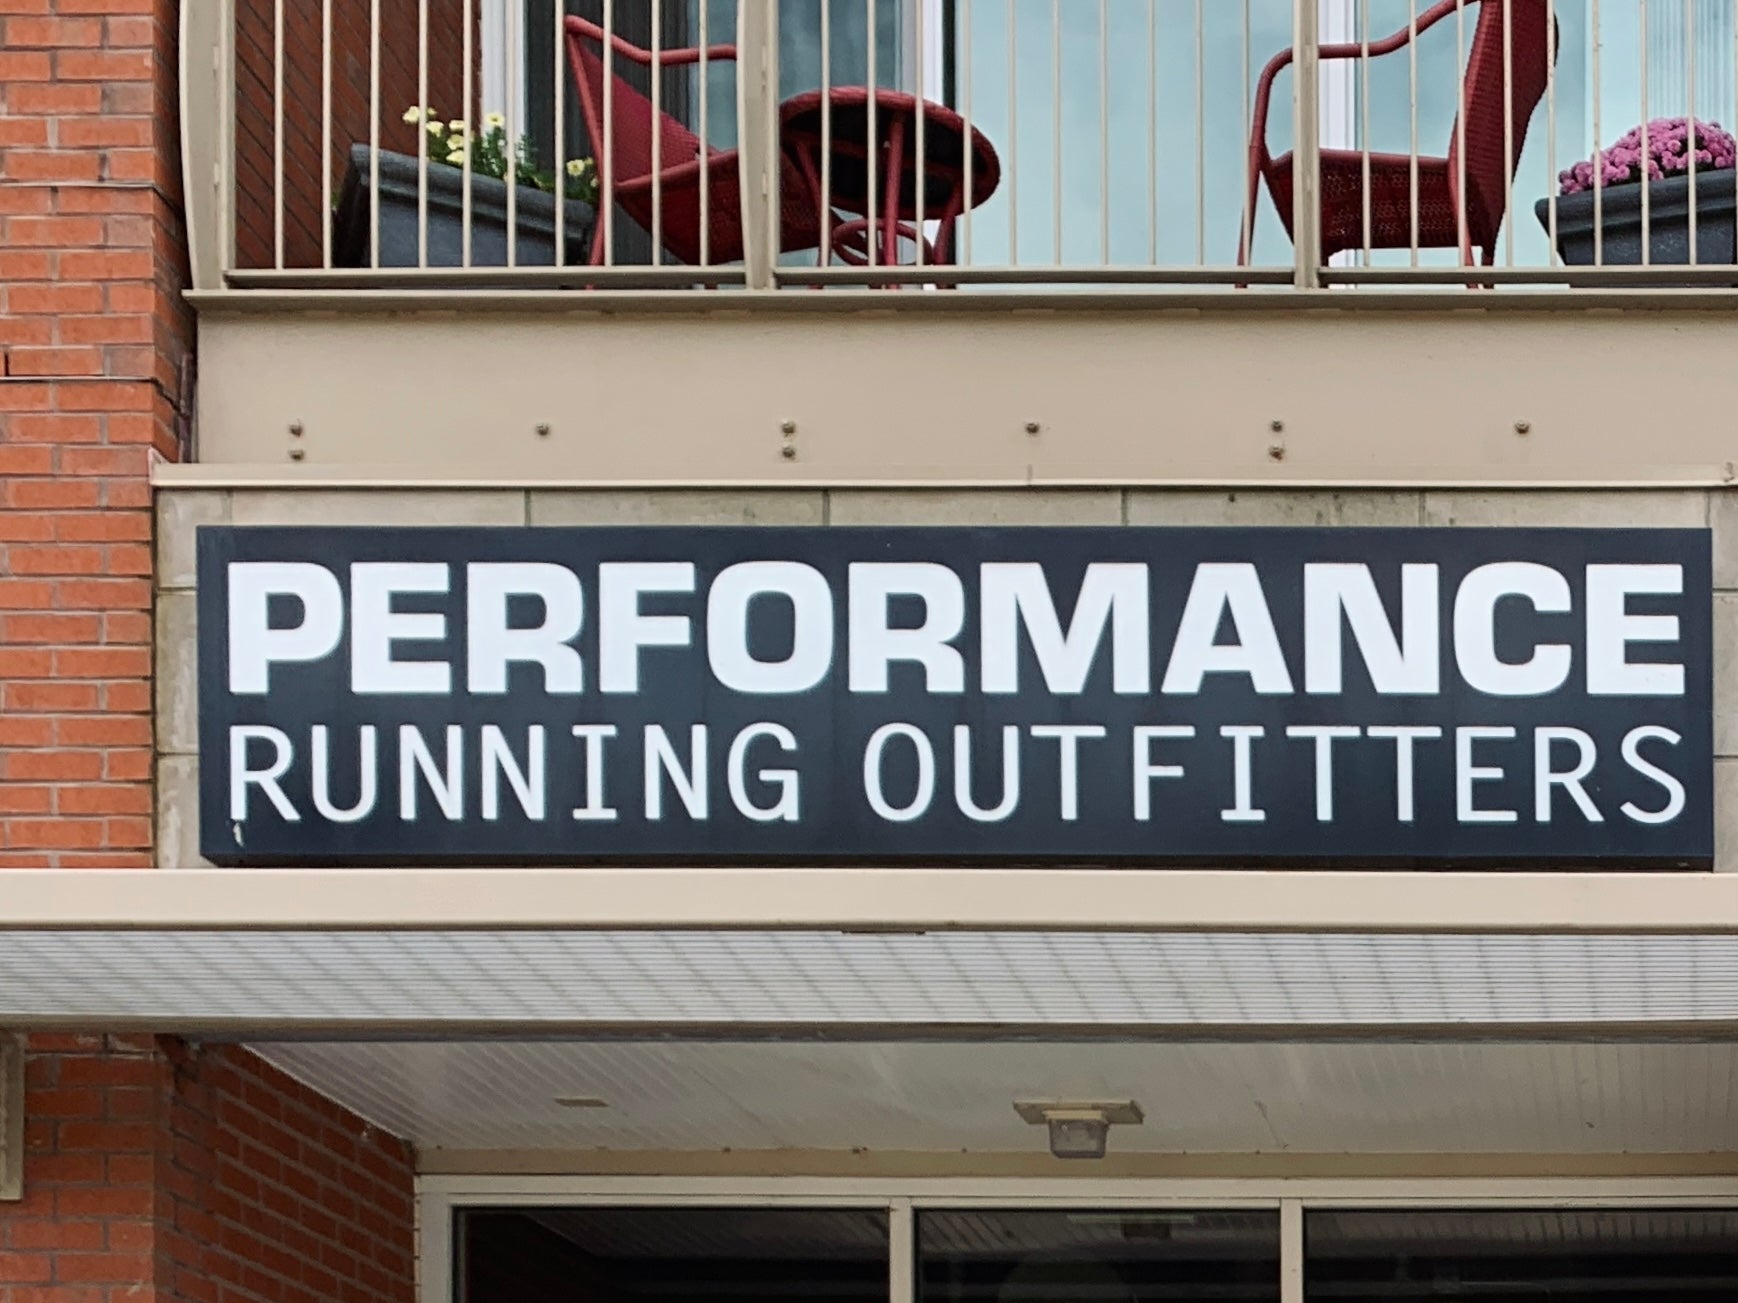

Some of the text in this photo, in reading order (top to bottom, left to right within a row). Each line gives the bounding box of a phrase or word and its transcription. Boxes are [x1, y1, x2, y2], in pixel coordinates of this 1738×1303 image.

[228, 561, 1685, 695] PERFORMANCE
[229, 723, 1686, 824] RUNNING OUTFITTERS
